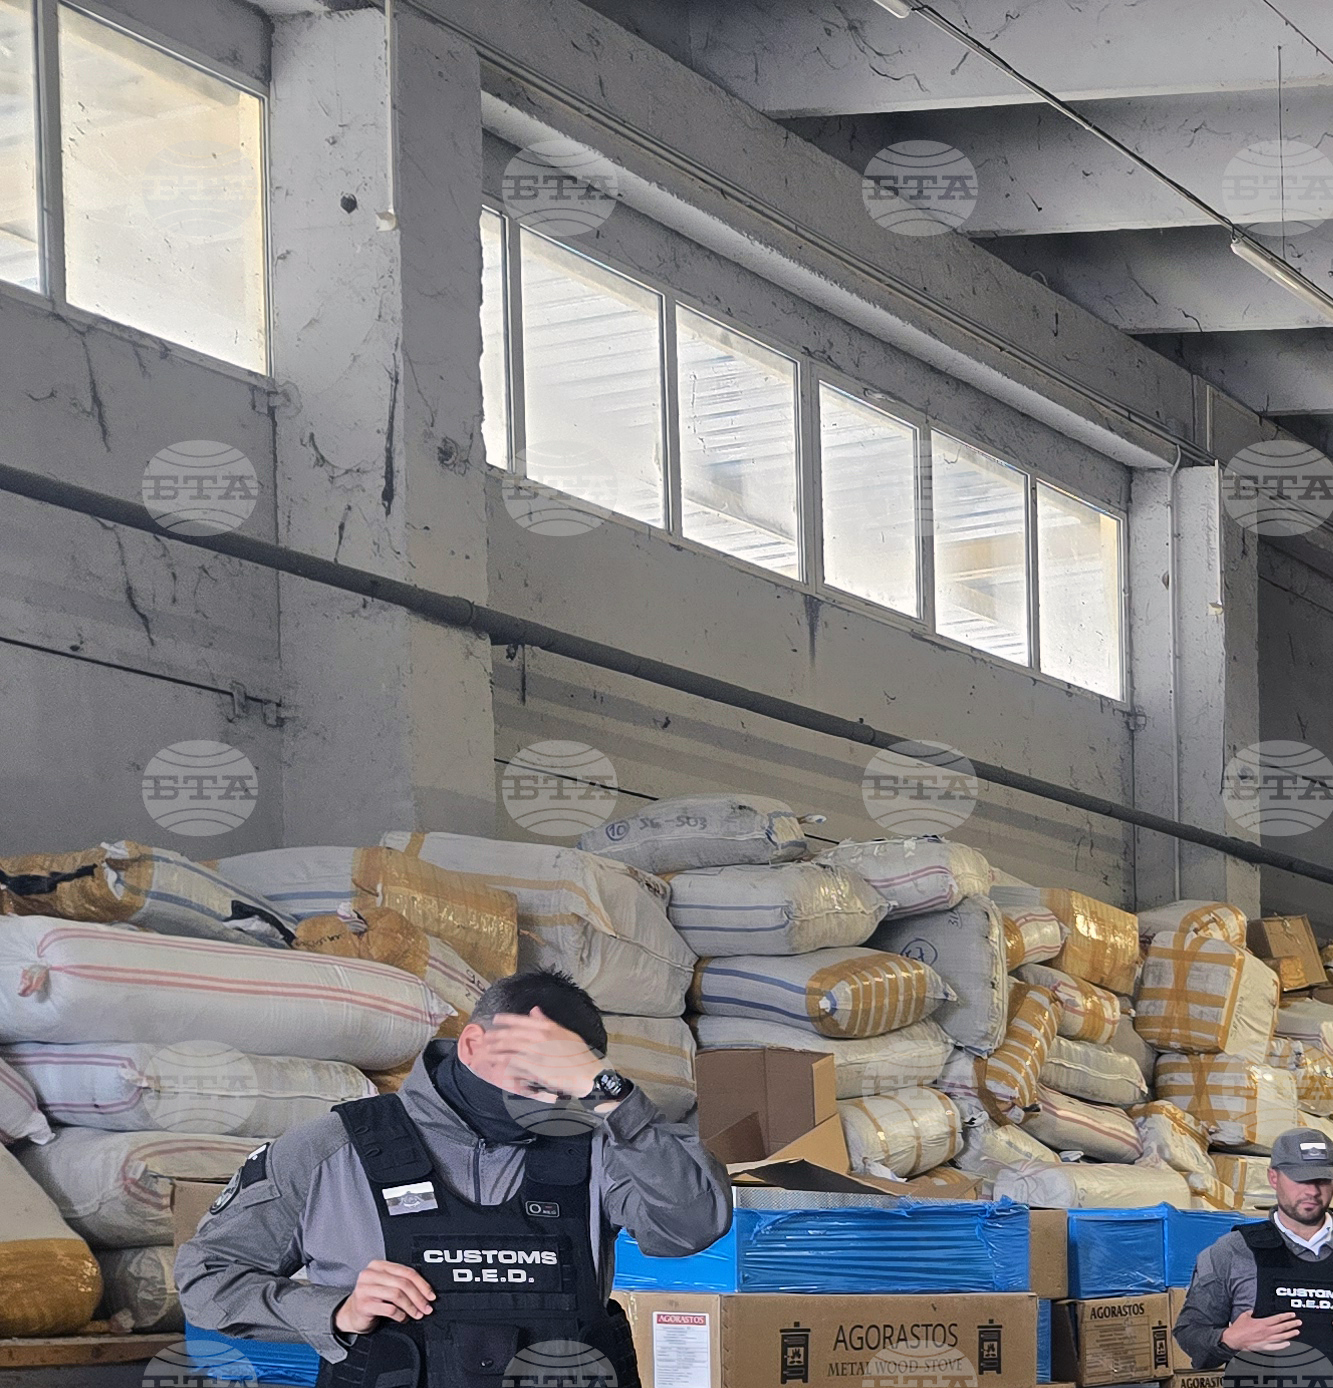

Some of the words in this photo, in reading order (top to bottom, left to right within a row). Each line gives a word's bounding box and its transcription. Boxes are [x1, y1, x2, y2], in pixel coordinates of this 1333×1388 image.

[423, 1249, 558, 1265] CUSTOMS
[452, 1268, 534, 1283] D.E.D.
[657, 1314, 706, 1325] AGORASTOS
[1090, 1303, 1145, 1320] AGORASTOS
[833, 1323, 958, 1351] AGORASTOS
[827, 1361, 872, 1377] METAL
[874, 1359, 918, 1374] WOOD
[924, 1358, 963, 1372] STOVE
